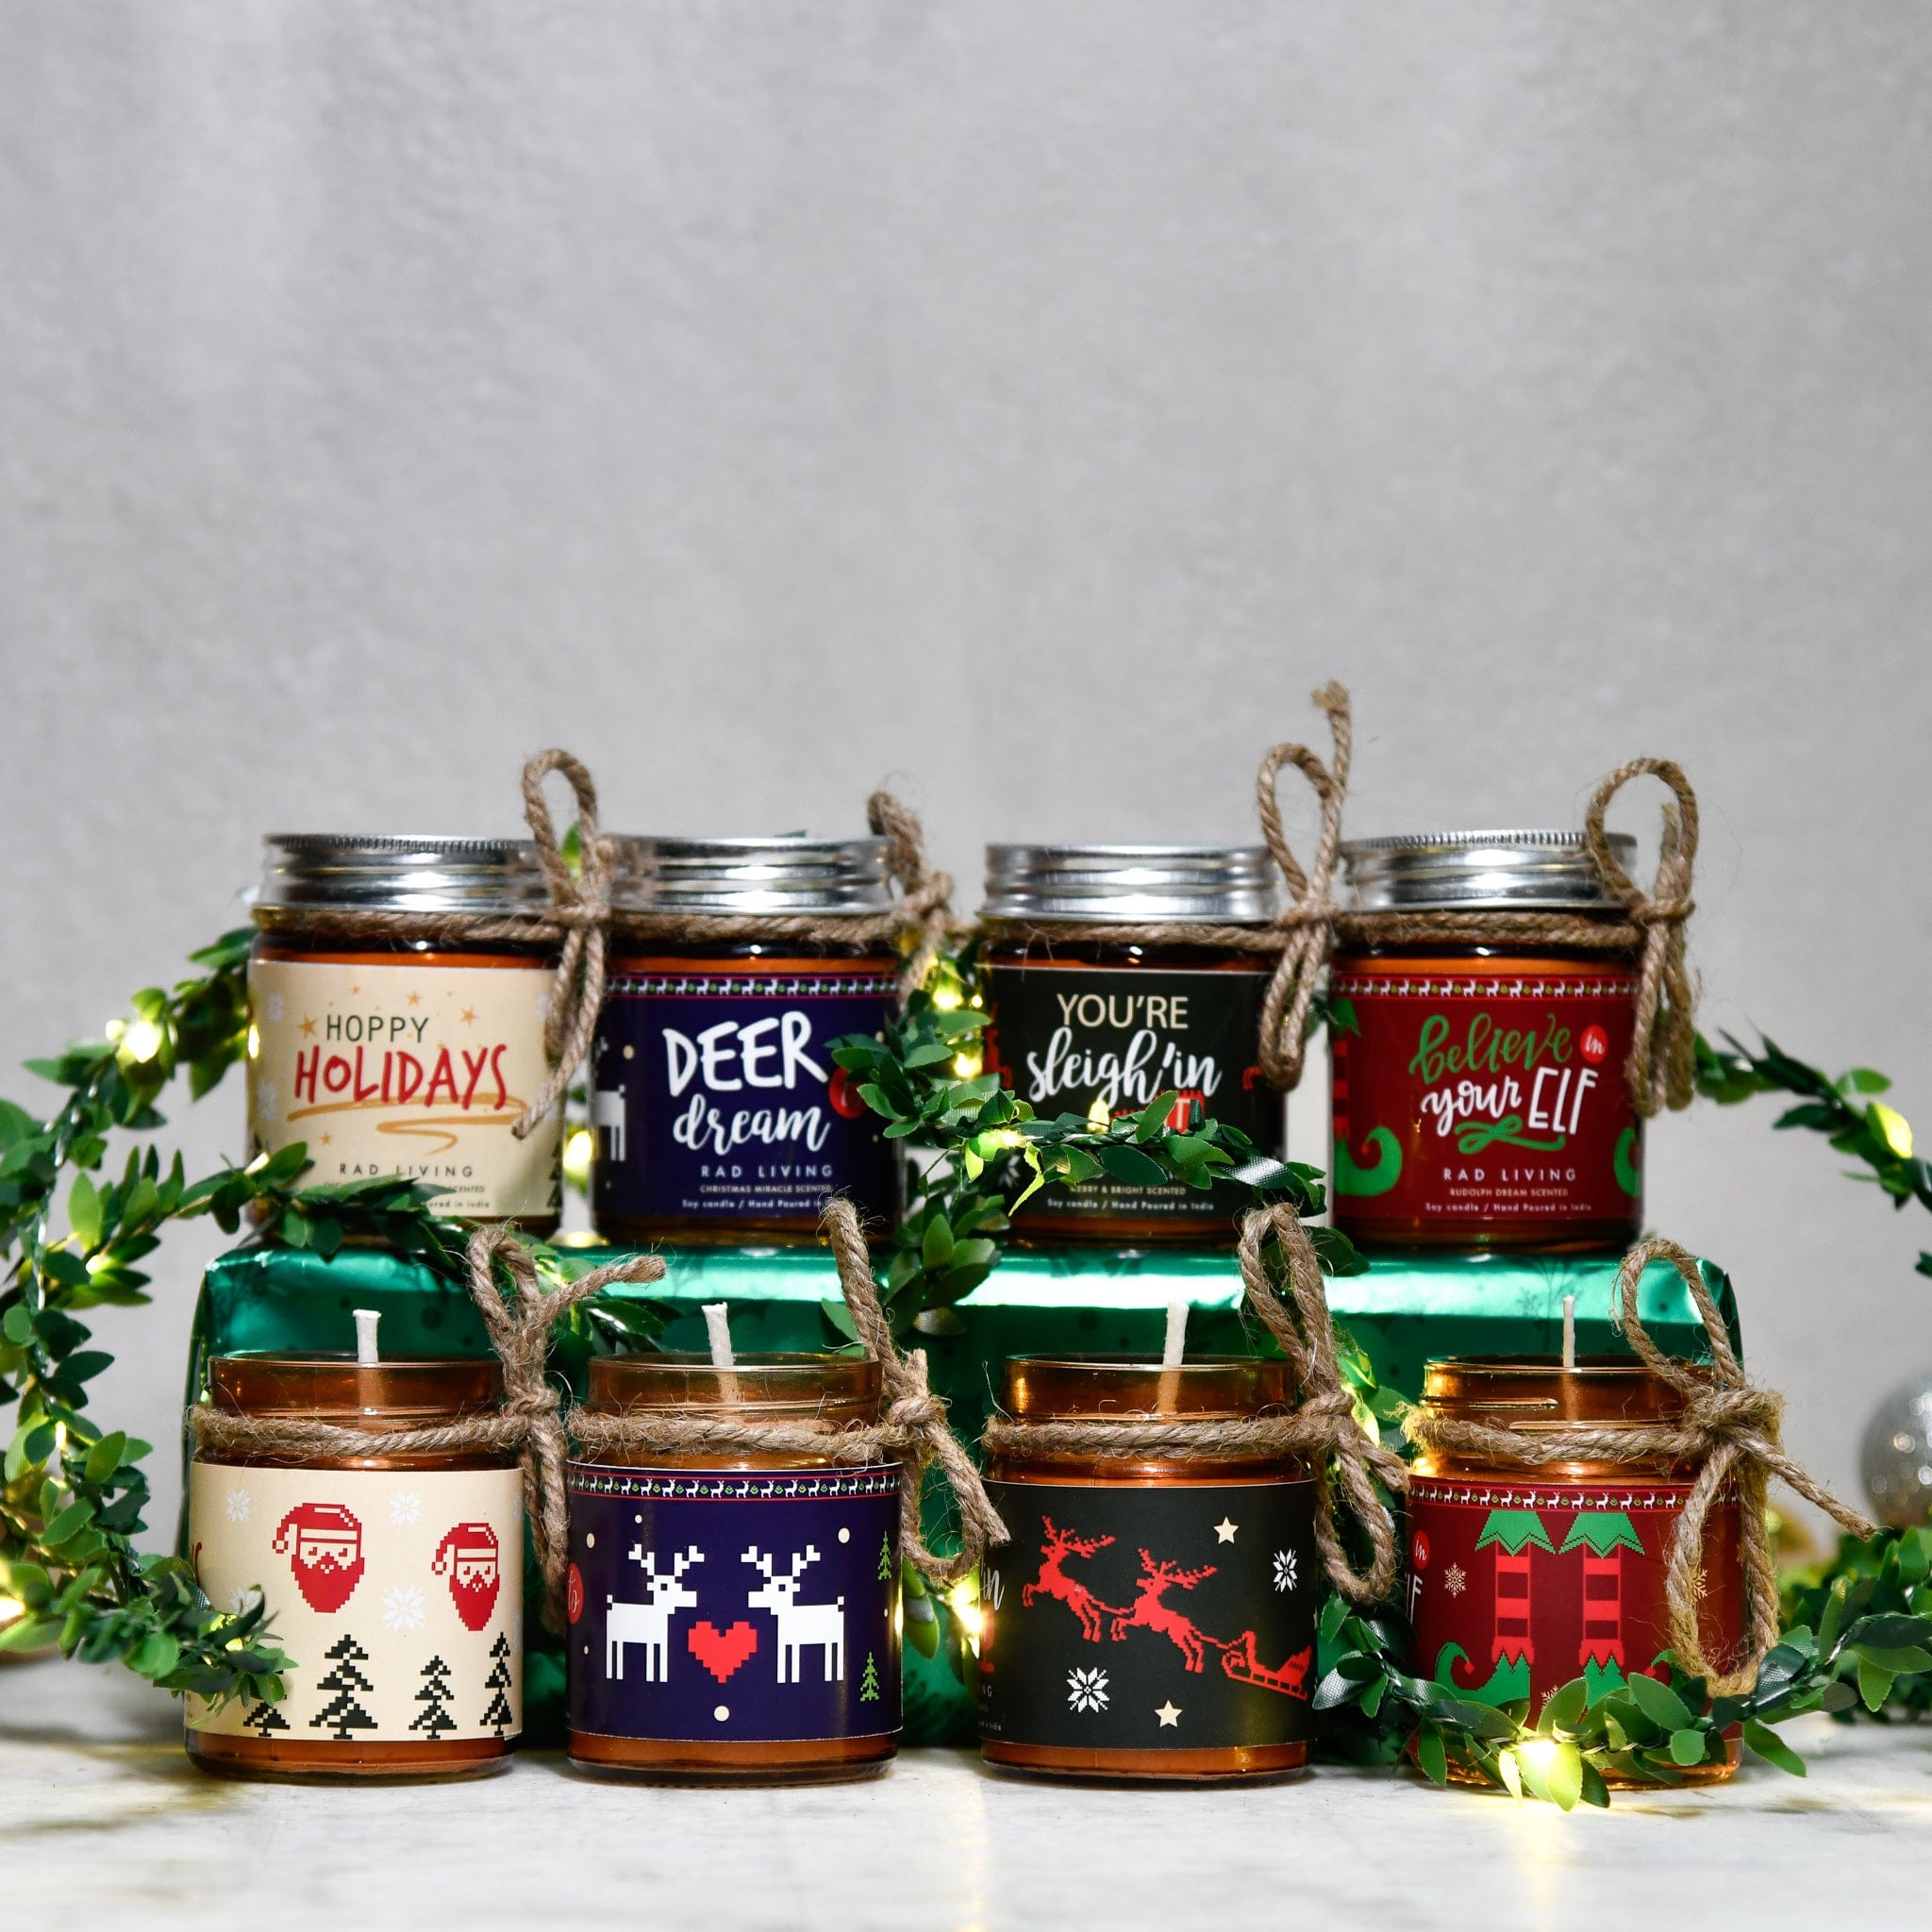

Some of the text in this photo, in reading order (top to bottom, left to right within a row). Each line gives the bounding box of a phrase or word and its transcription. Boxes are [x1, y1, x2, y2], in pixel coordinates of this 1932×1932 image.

[1057, 993, 1189, 1029] YOU'RE
[325, 1014, 429, 1043] HOPPY
[1584, 1033, 1604, 1055] in
[662, 1011, 828, 1097] DEER
[293, 1043, 507, 1110] HOLIDAYS
[1421, 1075, 1522, 1137] your
[673, 1093, 830, 1156] dream
[340, 1163, 474, 1177] RAD LIVING
[701, 1165, 833, 1178] RAD LIVING
[1443, 1168, 1576, 1181] RAD LIVING
[700, 1184, 832, 1193] CHRISTMAS MIRACLE SCENTED
[1111, 1187, 1144, 1195] BRIGHT
[1147, 1187, 1187, 1196] SCENTED
[1450, 1189, 1568, 1197] RUDOLPH DREAM SCENTED
[682, 1199, 699, 1208] Soy
[703, 1200, 734, 1208] candle
[749, 1200, 774, 1208] Hand
[777, 1200, 810, 1208] Poured
[1047, 1198, 1063, 1208] Soy
[1067, 1200, 1098, 1208] candle
[1111, 1201, 1138, 1209] Hand
[1141, 1202, 1175, 1210] Poured
[1191, 1202, 1214, 1211] India
[1425, 1203, 1442, 1212] Soy
[1447, 1203, 1479, 1211] candle
[1493, 1203, 1519, 1211] Hand
[1524, 1203, 1556, 1212] Poured
[1571, 1203, 1591, 1211] India
[1415, 1537, 1426, 1561] in
